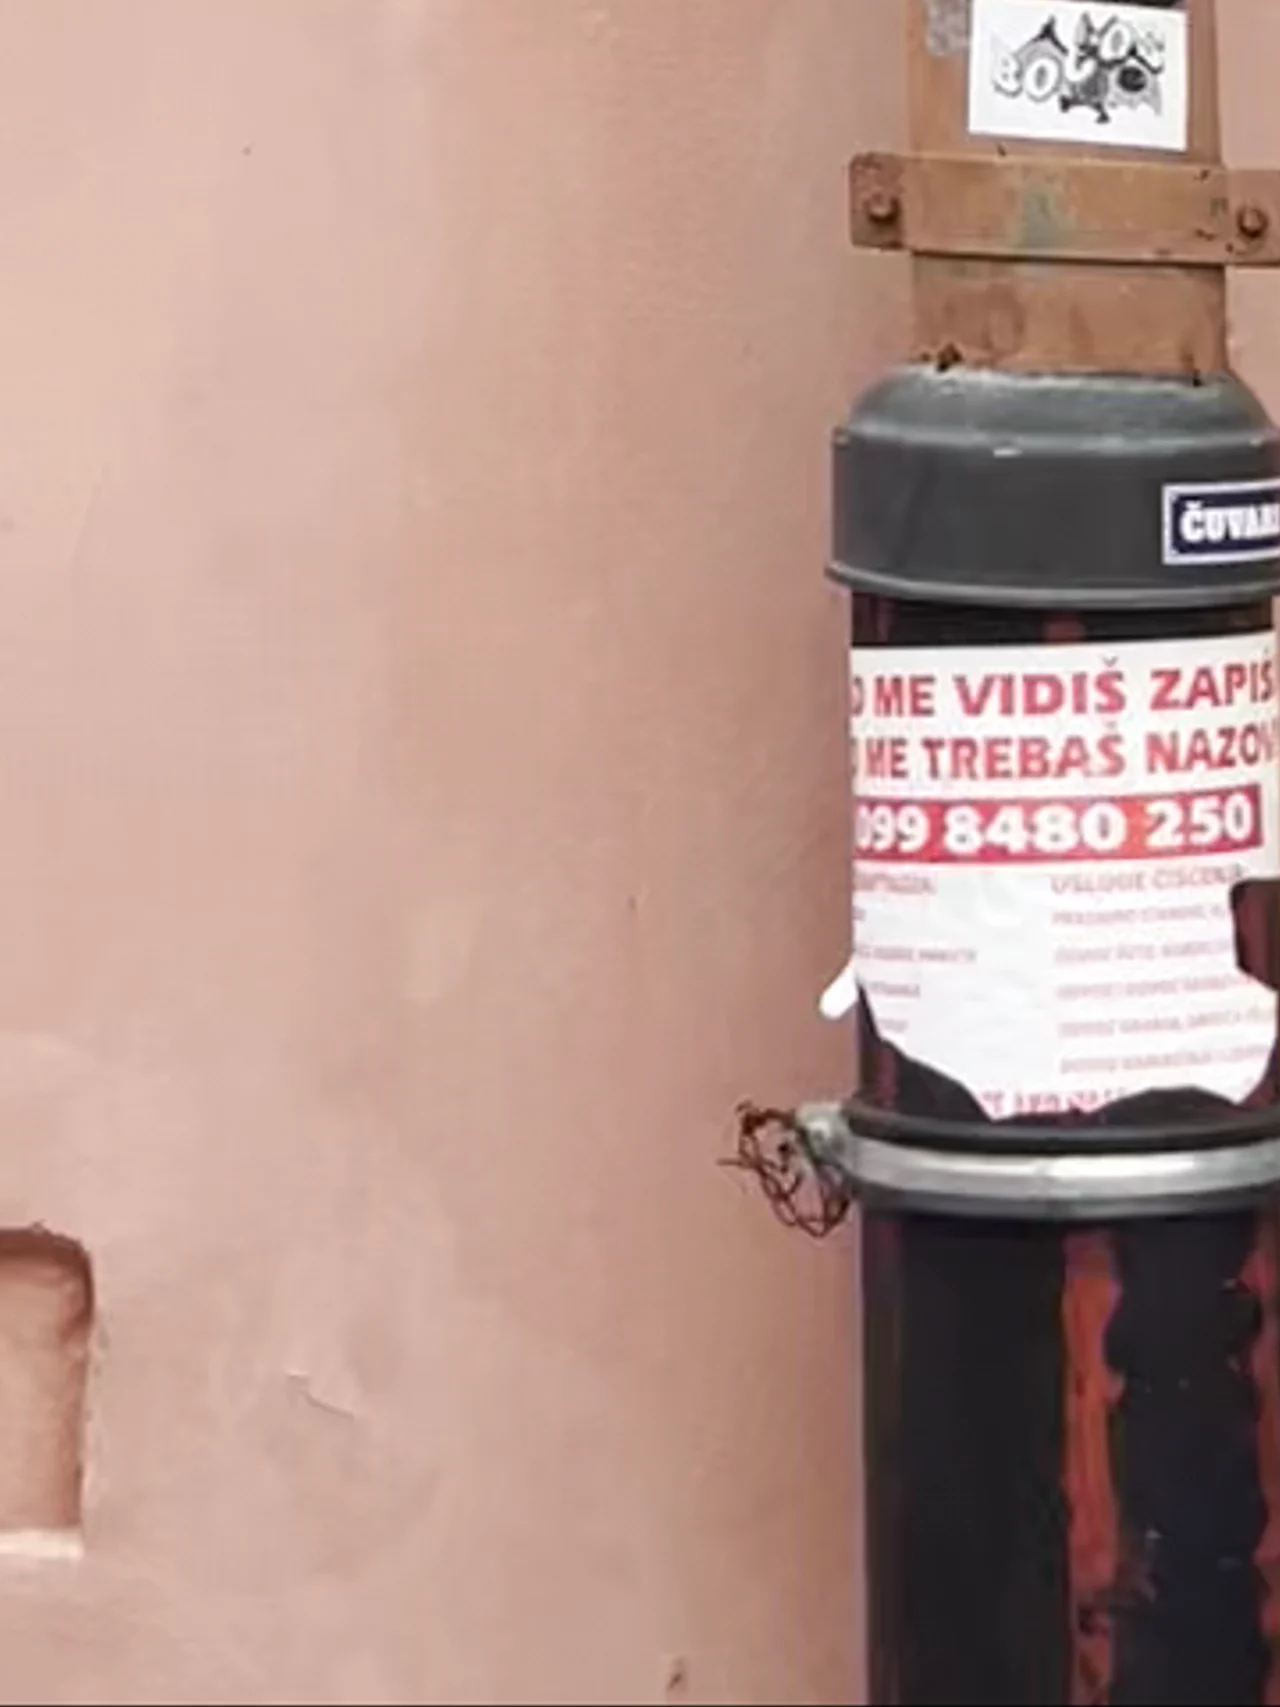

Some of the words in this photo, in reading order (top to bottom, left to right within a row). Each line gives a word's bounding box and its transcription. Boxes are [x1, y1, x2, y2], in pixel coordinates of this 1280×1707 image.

[874, 674, 935, 717] ME
[953, 655, 1126, 716] VIDIŠ
[866, 737, 908, 778] ME
[922, 721, 1126, 779] TREBAŠ
[943, 802, 1127, 854] 8480
[1144, 793, 1253, 851] 250
